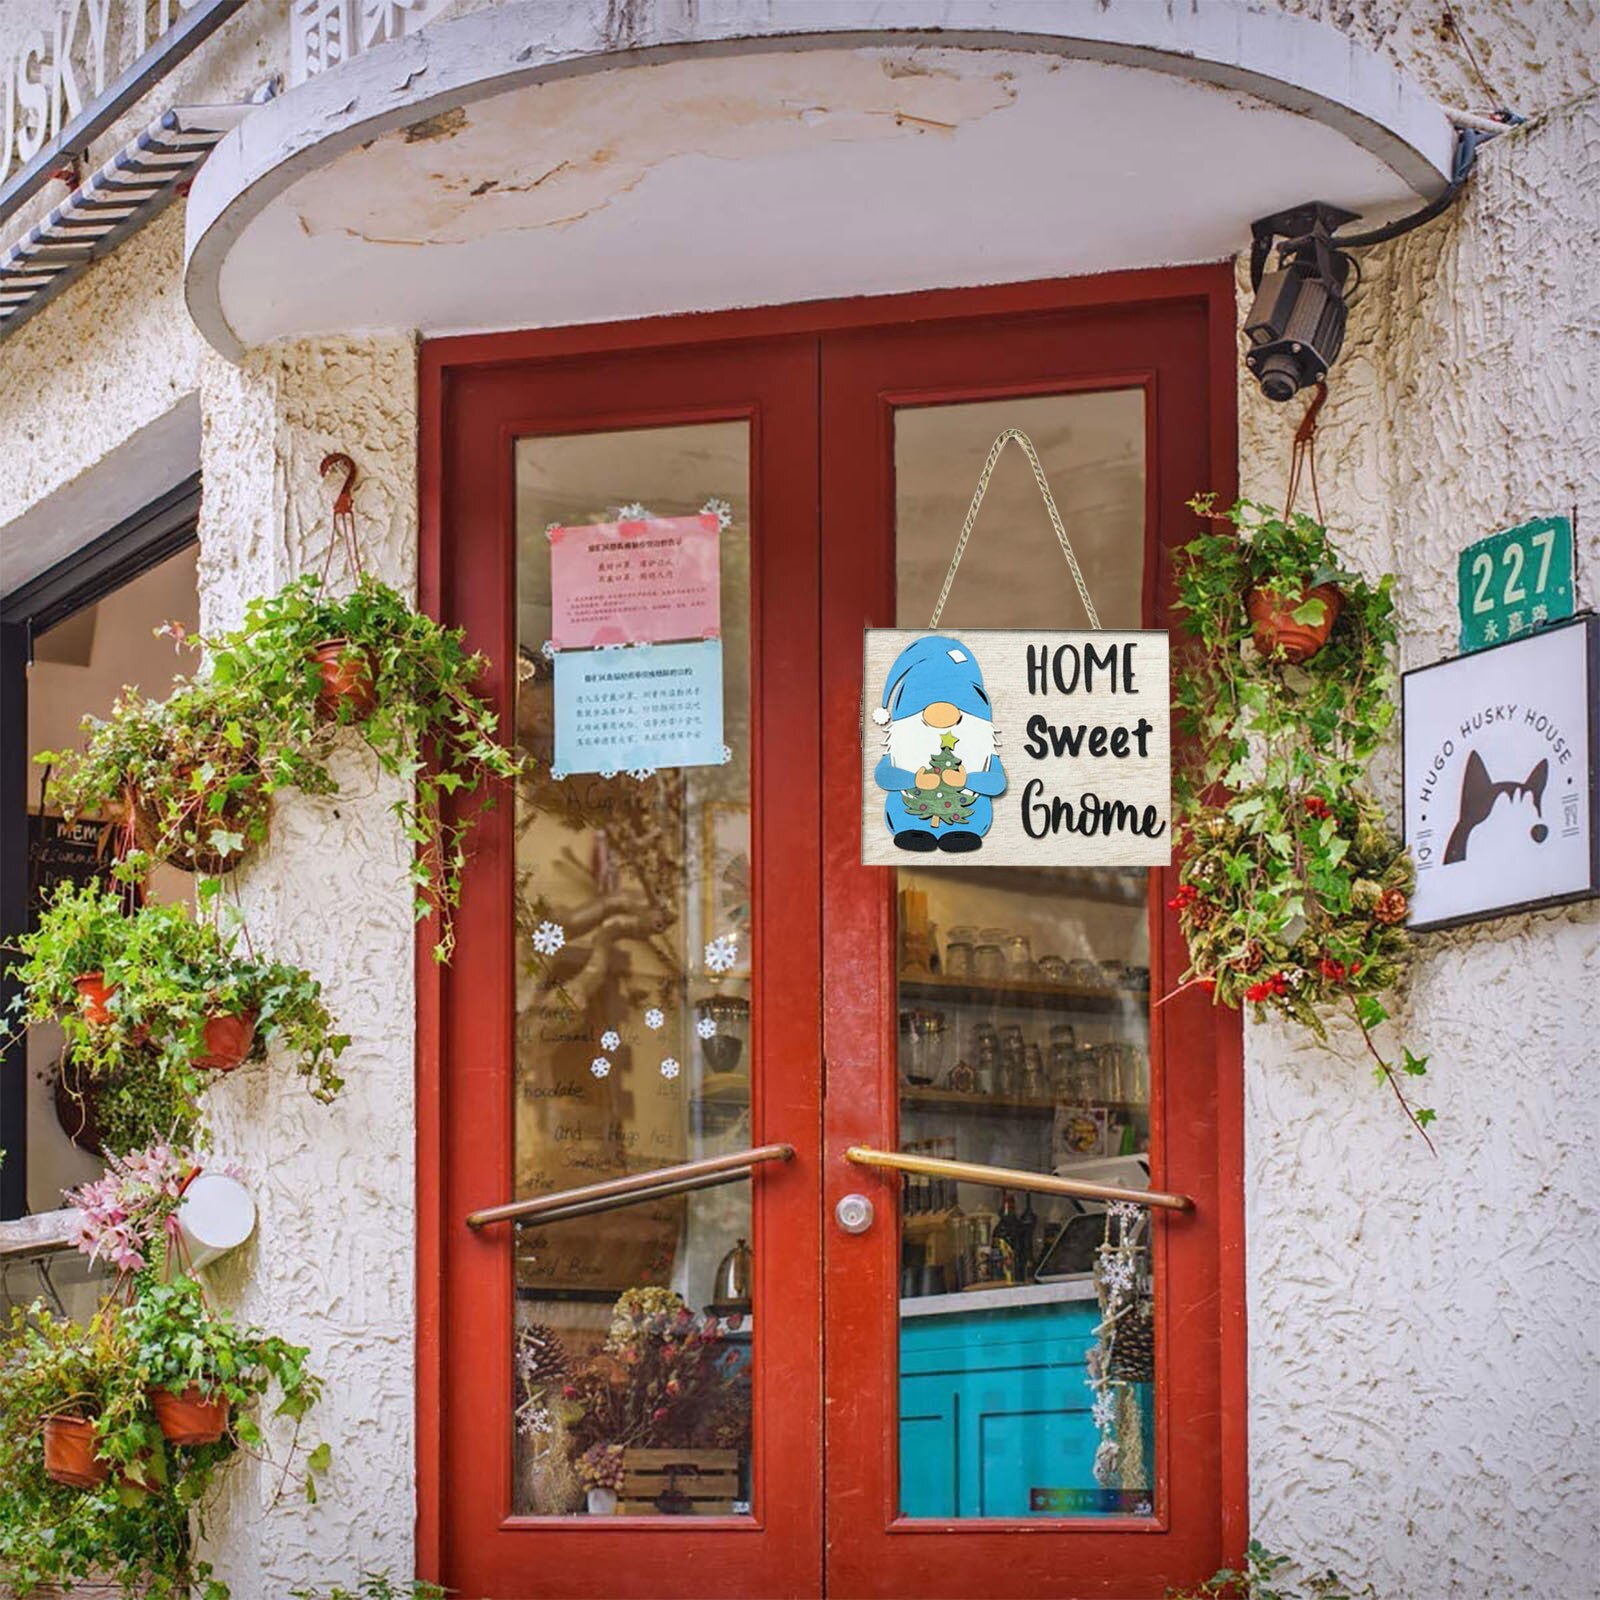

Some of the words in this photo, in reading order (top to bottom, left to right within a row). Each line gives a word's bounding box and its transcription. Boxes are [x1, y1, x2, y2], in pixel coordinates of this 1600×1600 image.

[1472, 529, 1555, 614] 227
[1027, 643, 1139, 695] HOME
[1024, 714, 1153, 759] Sweet
[1419, 740, 1455, 803] HUGO
[1459, 704, 1518, 738] HUSKY
[1523, 708, 1573, 766] HOUSE
[1021, 778, 1166, 839] Gnome
